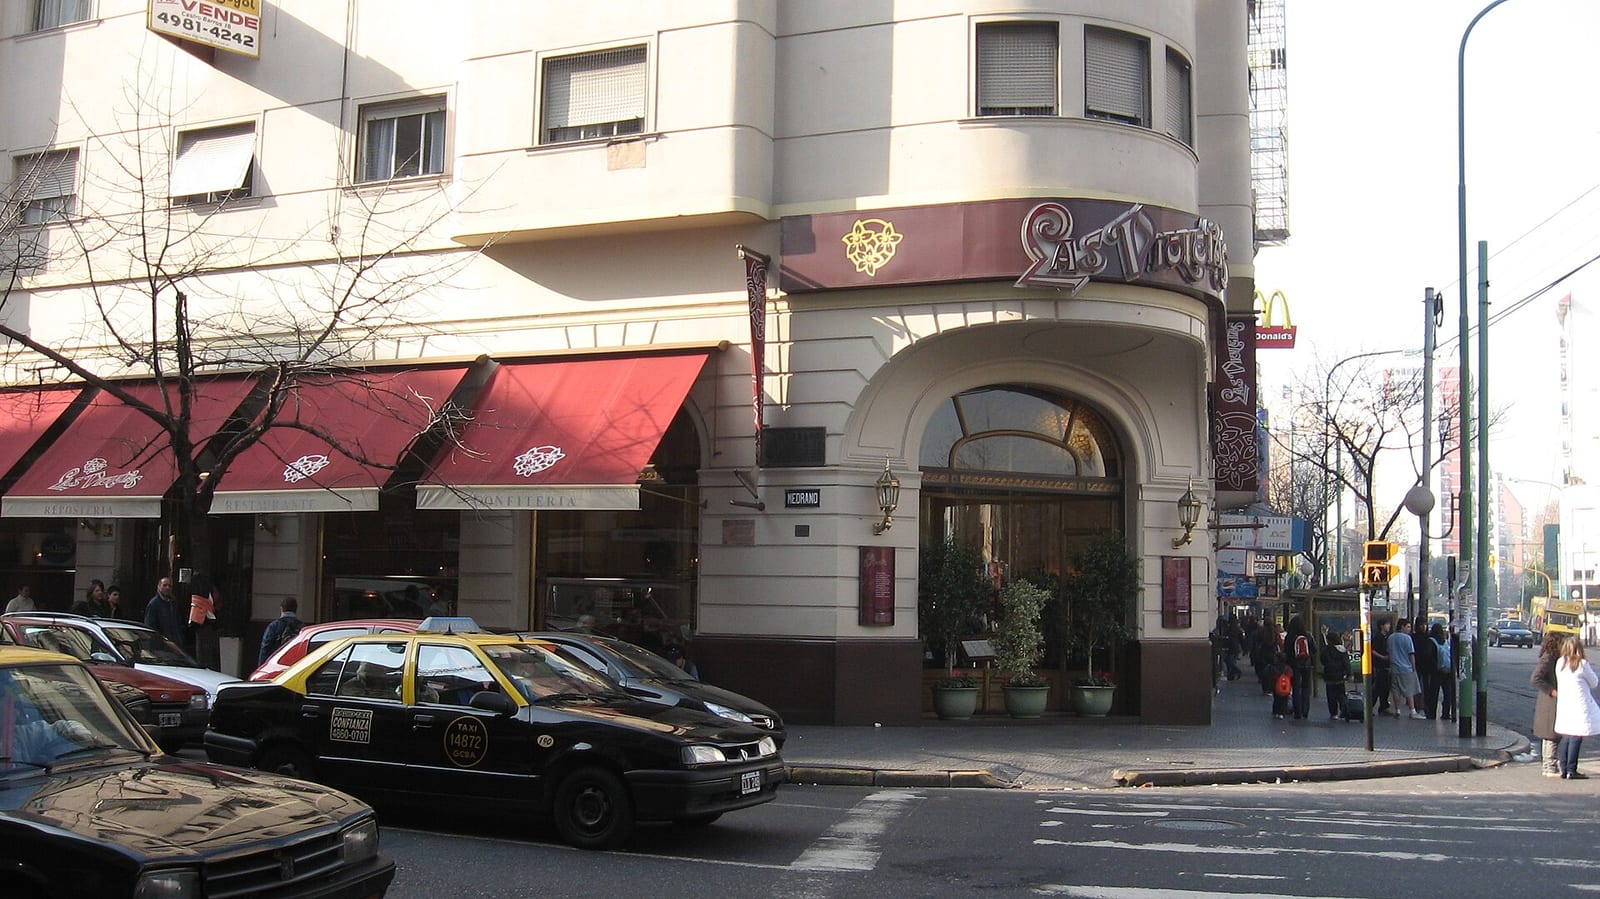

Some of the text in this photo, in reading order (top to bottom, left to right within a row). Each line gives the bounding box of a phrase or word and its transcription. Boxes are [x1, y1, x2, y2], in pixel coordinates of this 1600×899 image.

[181, 0, 258, 30] VENDE
[157, 12, 254, 48] 4981-4242
[787, 492, 818, 504] MEDRANO
[44, 505, 113, 515] REPOSTERIA
[333, 717, 369, 730] CONFIANZA
[457, 723, 478, 733] TAXI
[449, 733, 482, 749] 14872
